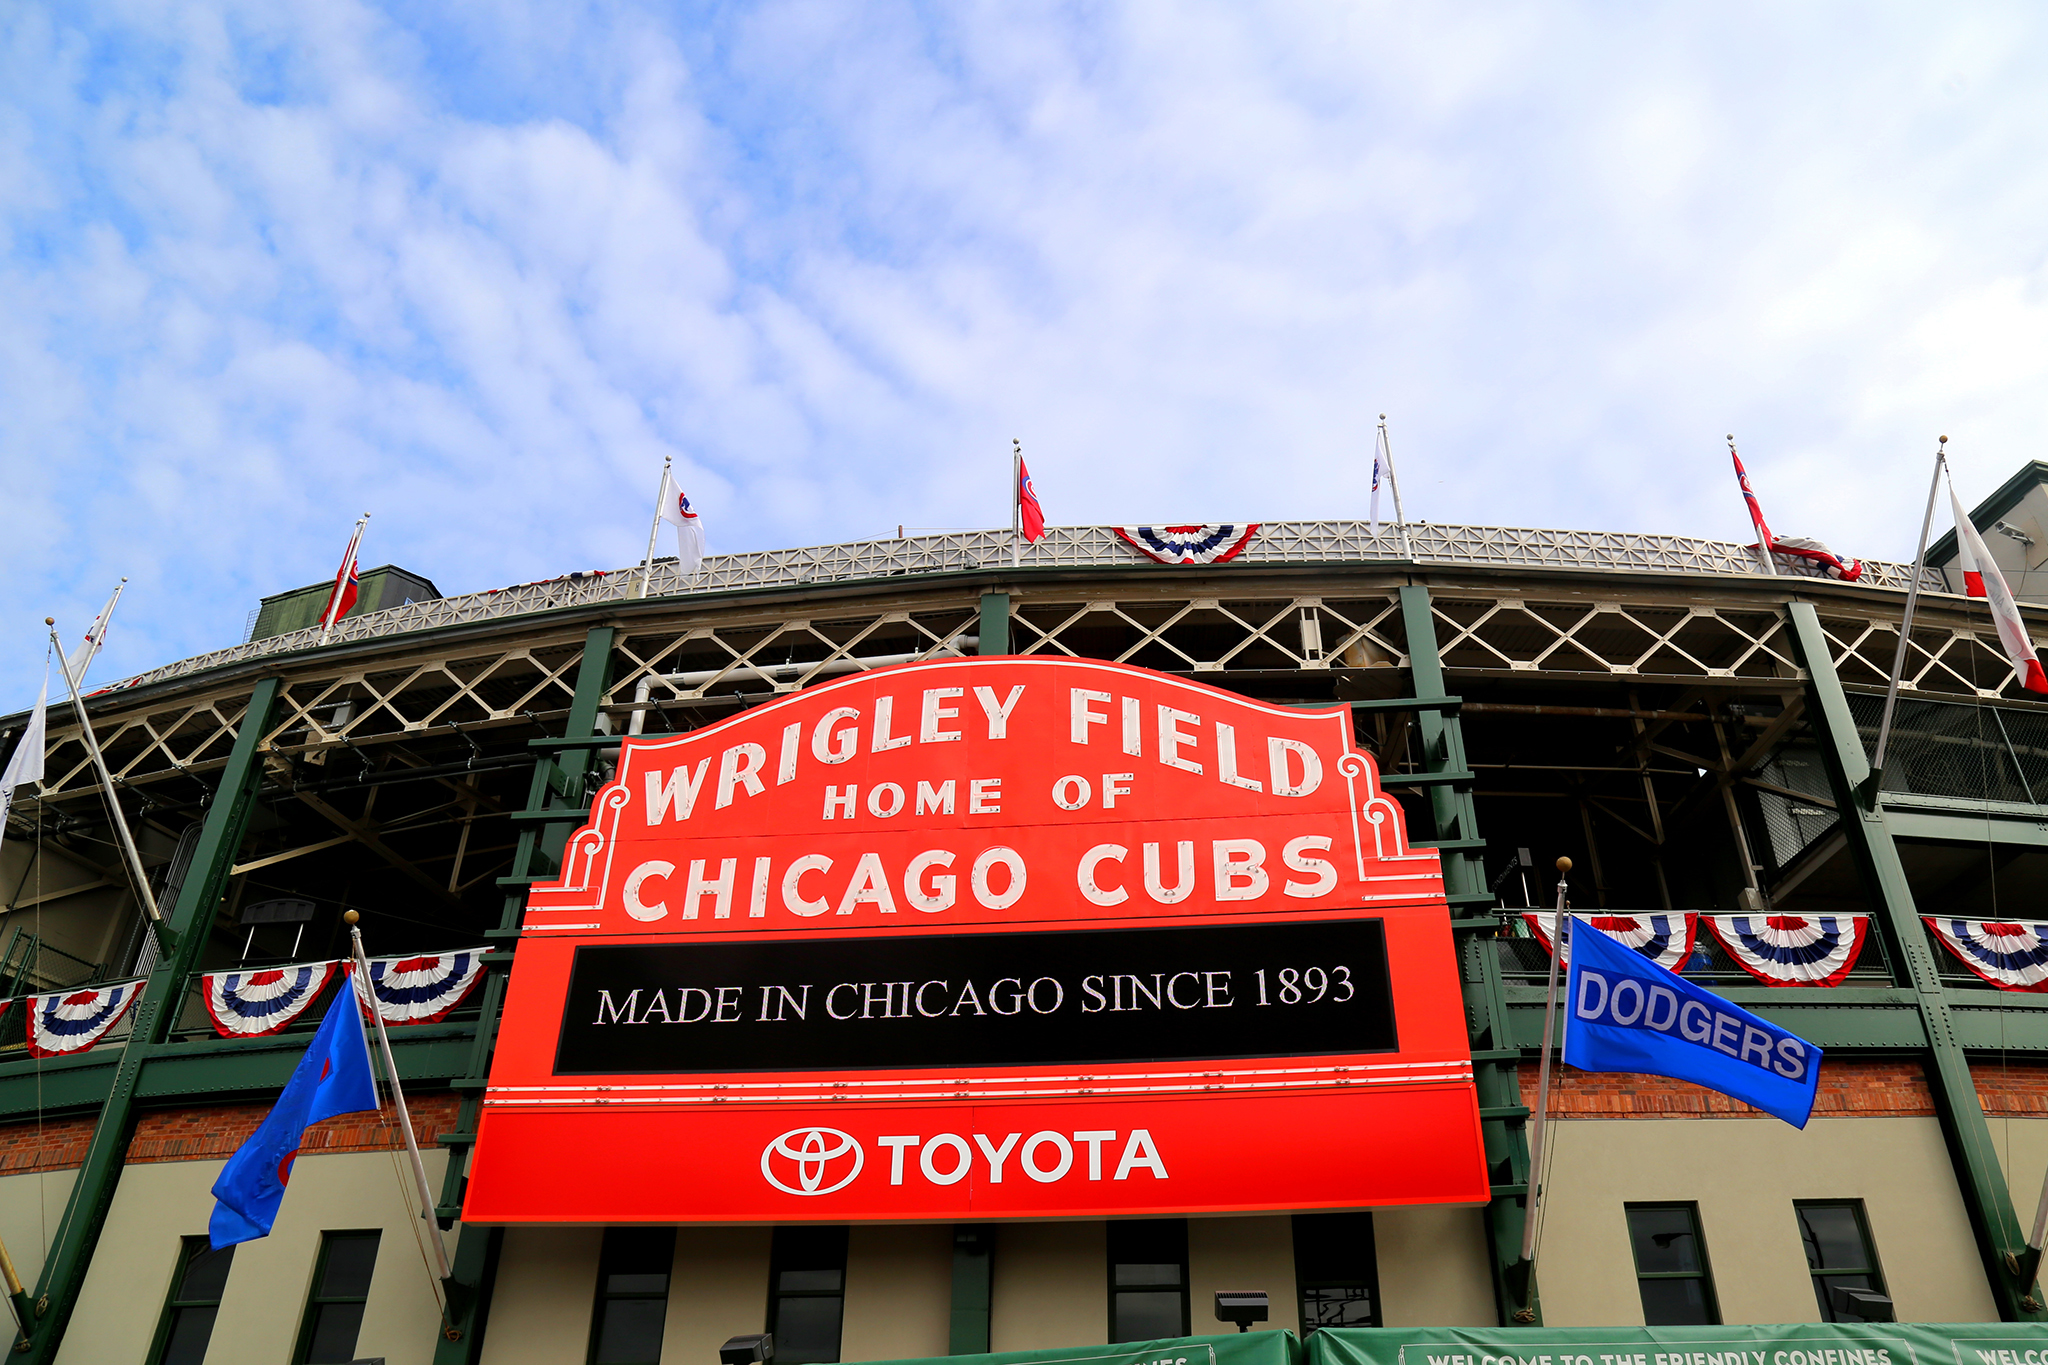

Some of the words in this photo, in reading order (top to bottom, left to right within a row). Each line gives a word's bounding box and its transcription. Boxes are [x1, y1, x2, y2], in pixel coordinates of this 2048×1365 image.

[644, 685, 1026, 826] WRIGLEY
[1070, 687, 1323, 797] FIELD
[822, 778, 1001, 820] HOME
[1052, 773, 1134, 811] OF
[623, 845, 1027, 922] CHICAGO
[1077, 835, 1338, 907] CUBS
[592, 986, 744, 1025] MADE
[755, 984, 814, 1022] IN
[826, 977, 1064, 1020] CHICAGO
[1081, 971, 1235, 1014] SINCE
[1254, 965, 1355, 1006] 1893
[1577, 970, 1806, 1080] DODGERS
[877, 1129, 1169, 1186] TOYOTA
[1427, 1355, 1552, 1365] WELCOME
[1560, 1355, 1594, 1365] TO
[1600, 1354, 1647, 1365] THE
[1655, 1351, 1766, 1365] FRIENDLY
[1774, 1349, 1892, 1365] CONFINES
